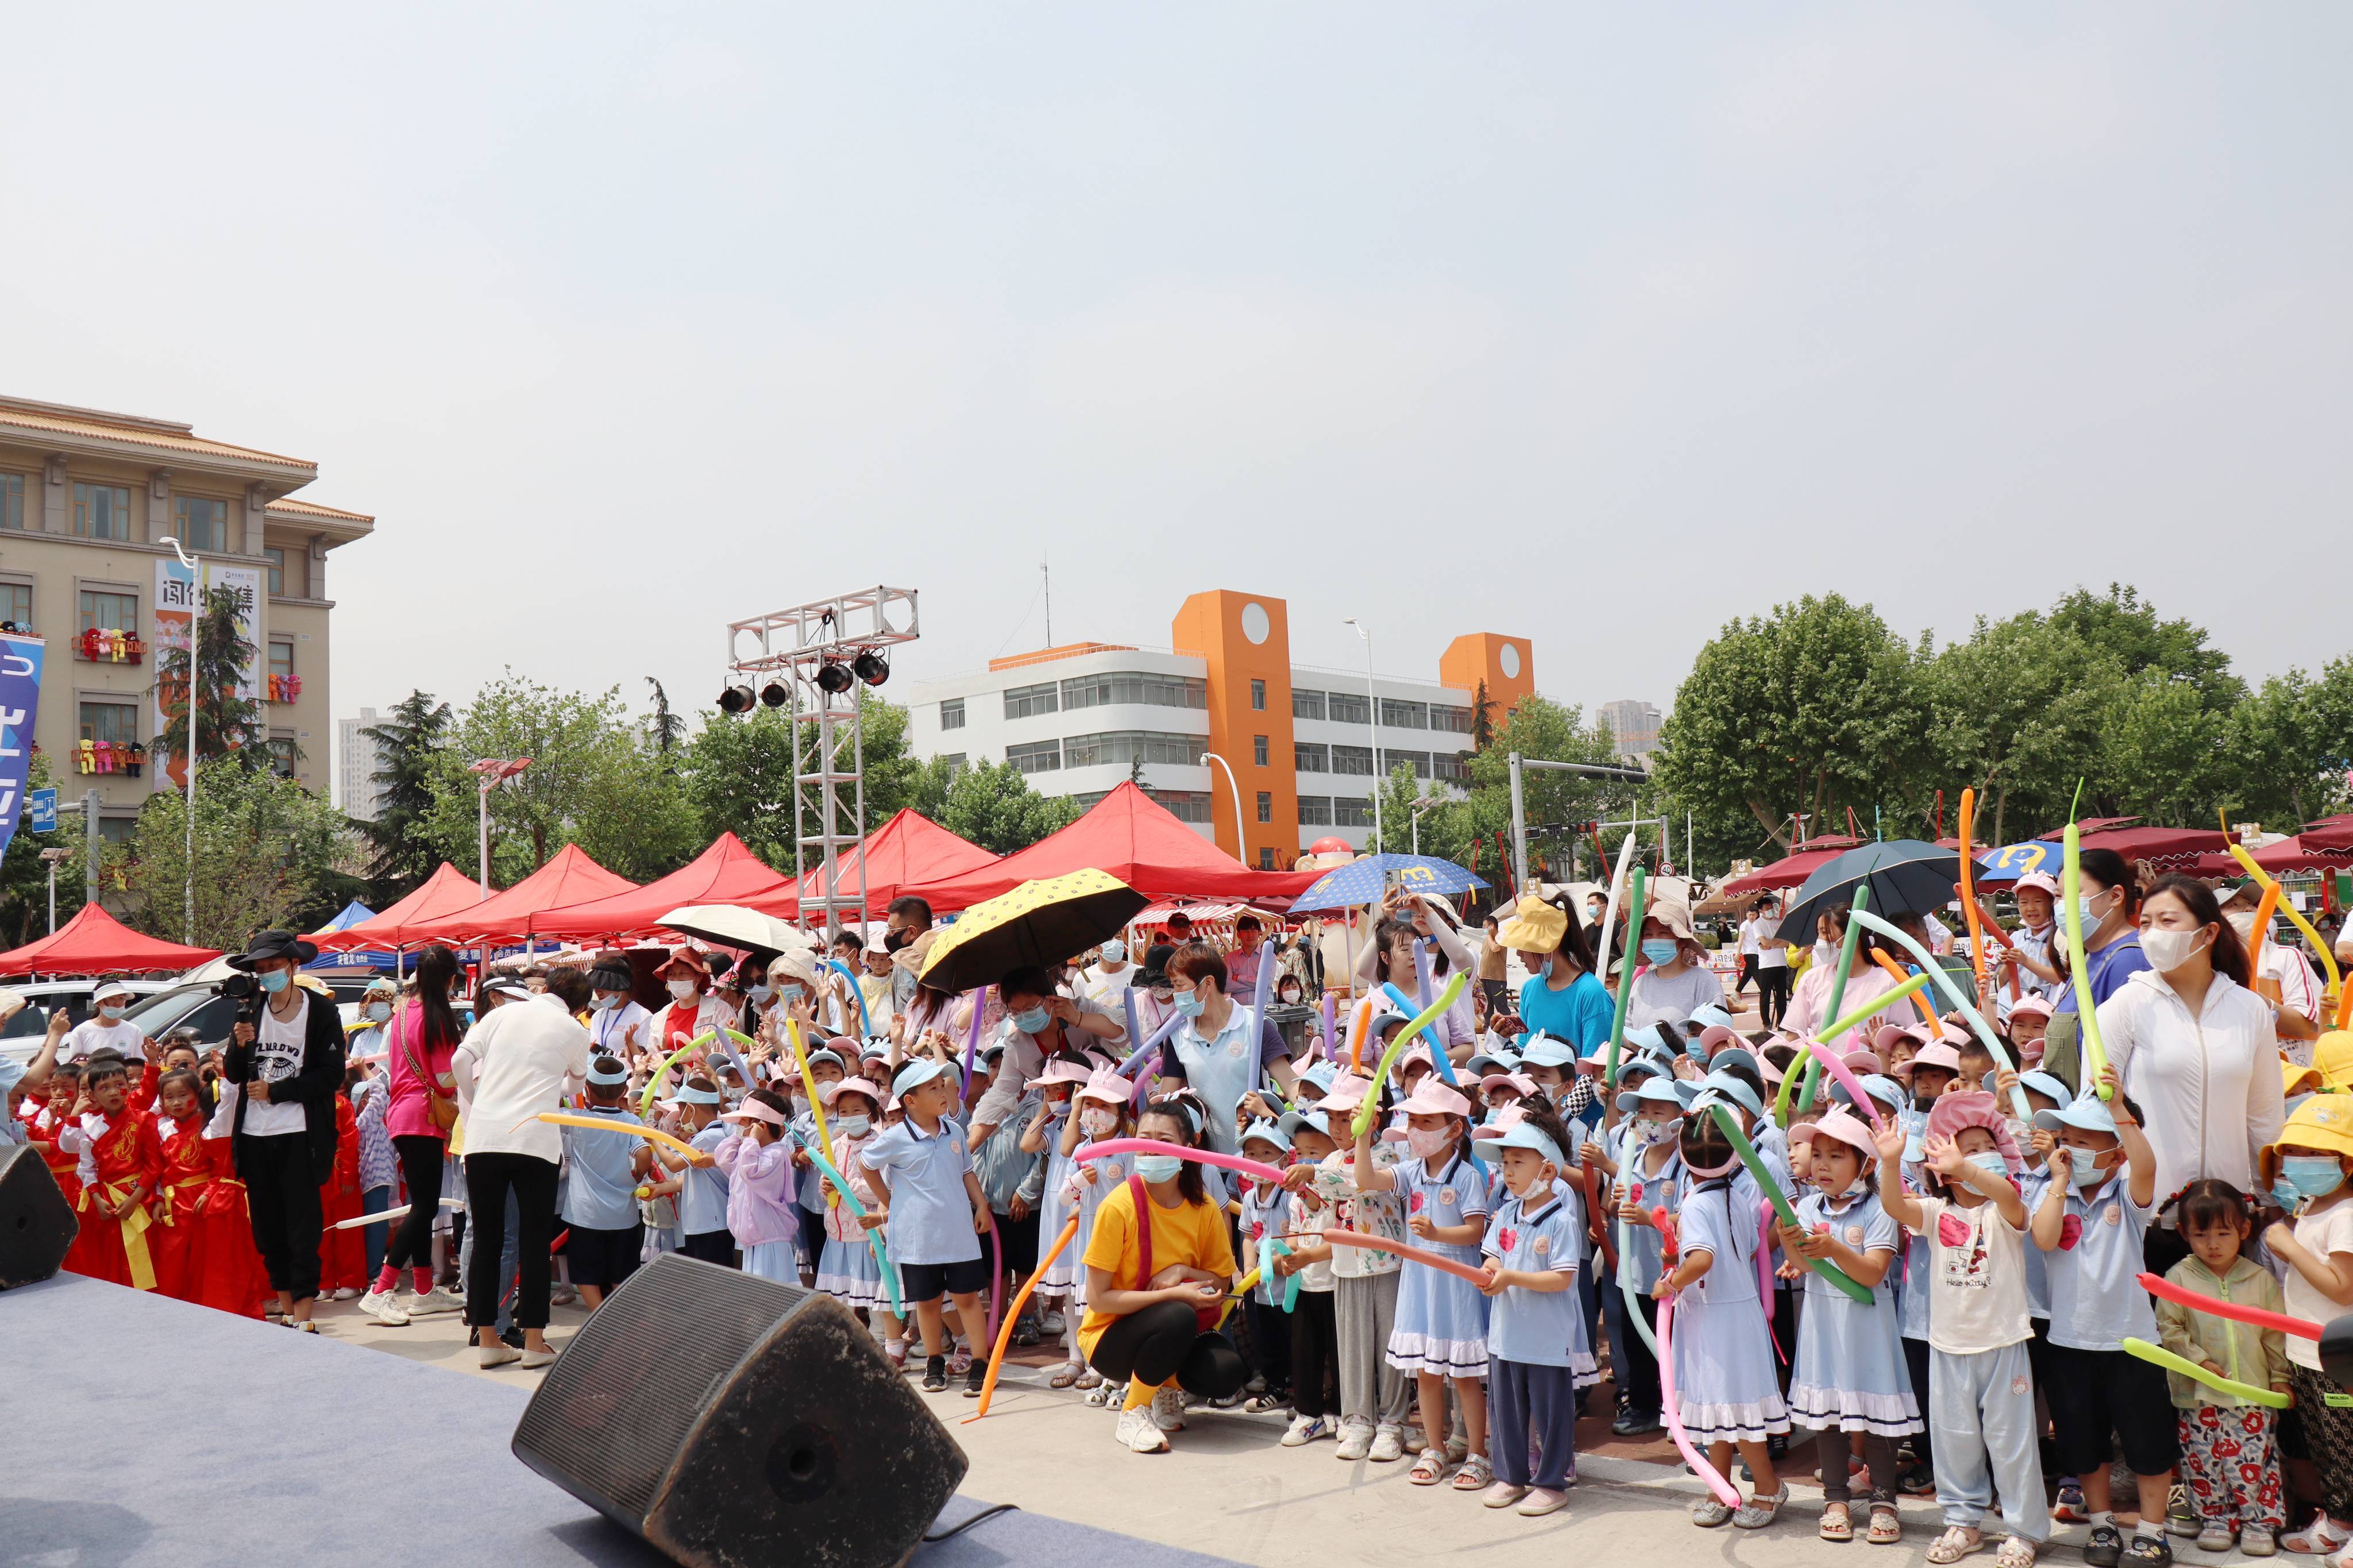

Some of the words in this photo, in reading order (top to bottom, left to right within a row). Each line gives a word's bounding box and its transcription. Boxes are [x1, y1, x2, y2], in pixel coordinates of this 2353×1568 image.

[496, 948, 519, 957] 会员店
[1946, 1278, 1963, 1287] Hello
